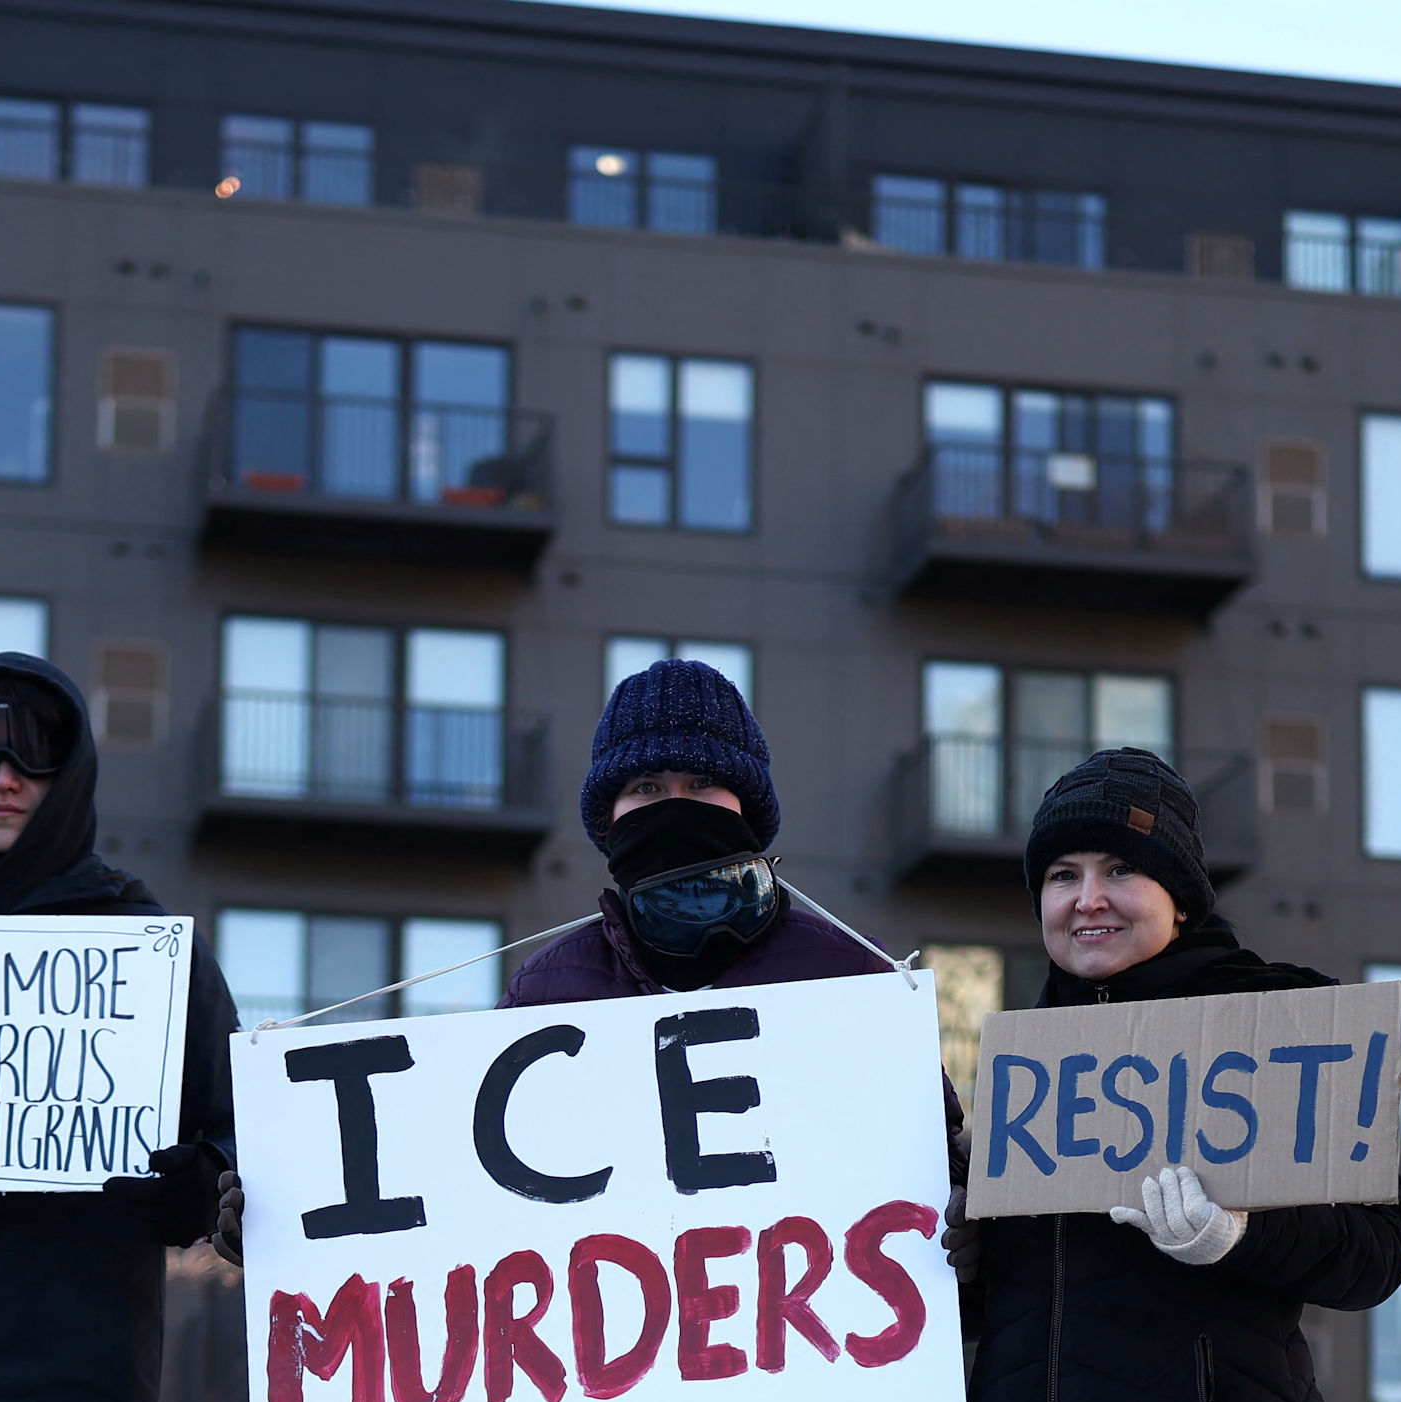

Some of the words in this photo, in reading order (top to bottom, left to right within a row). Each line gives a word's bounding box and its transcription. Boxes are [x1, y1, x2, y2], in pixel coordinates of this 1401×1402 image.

[3, 946, 141, 1020] MORE
[285, 1007, 778, 1240] ICE
[987, 1031, 1389, 1178] RESIST!
